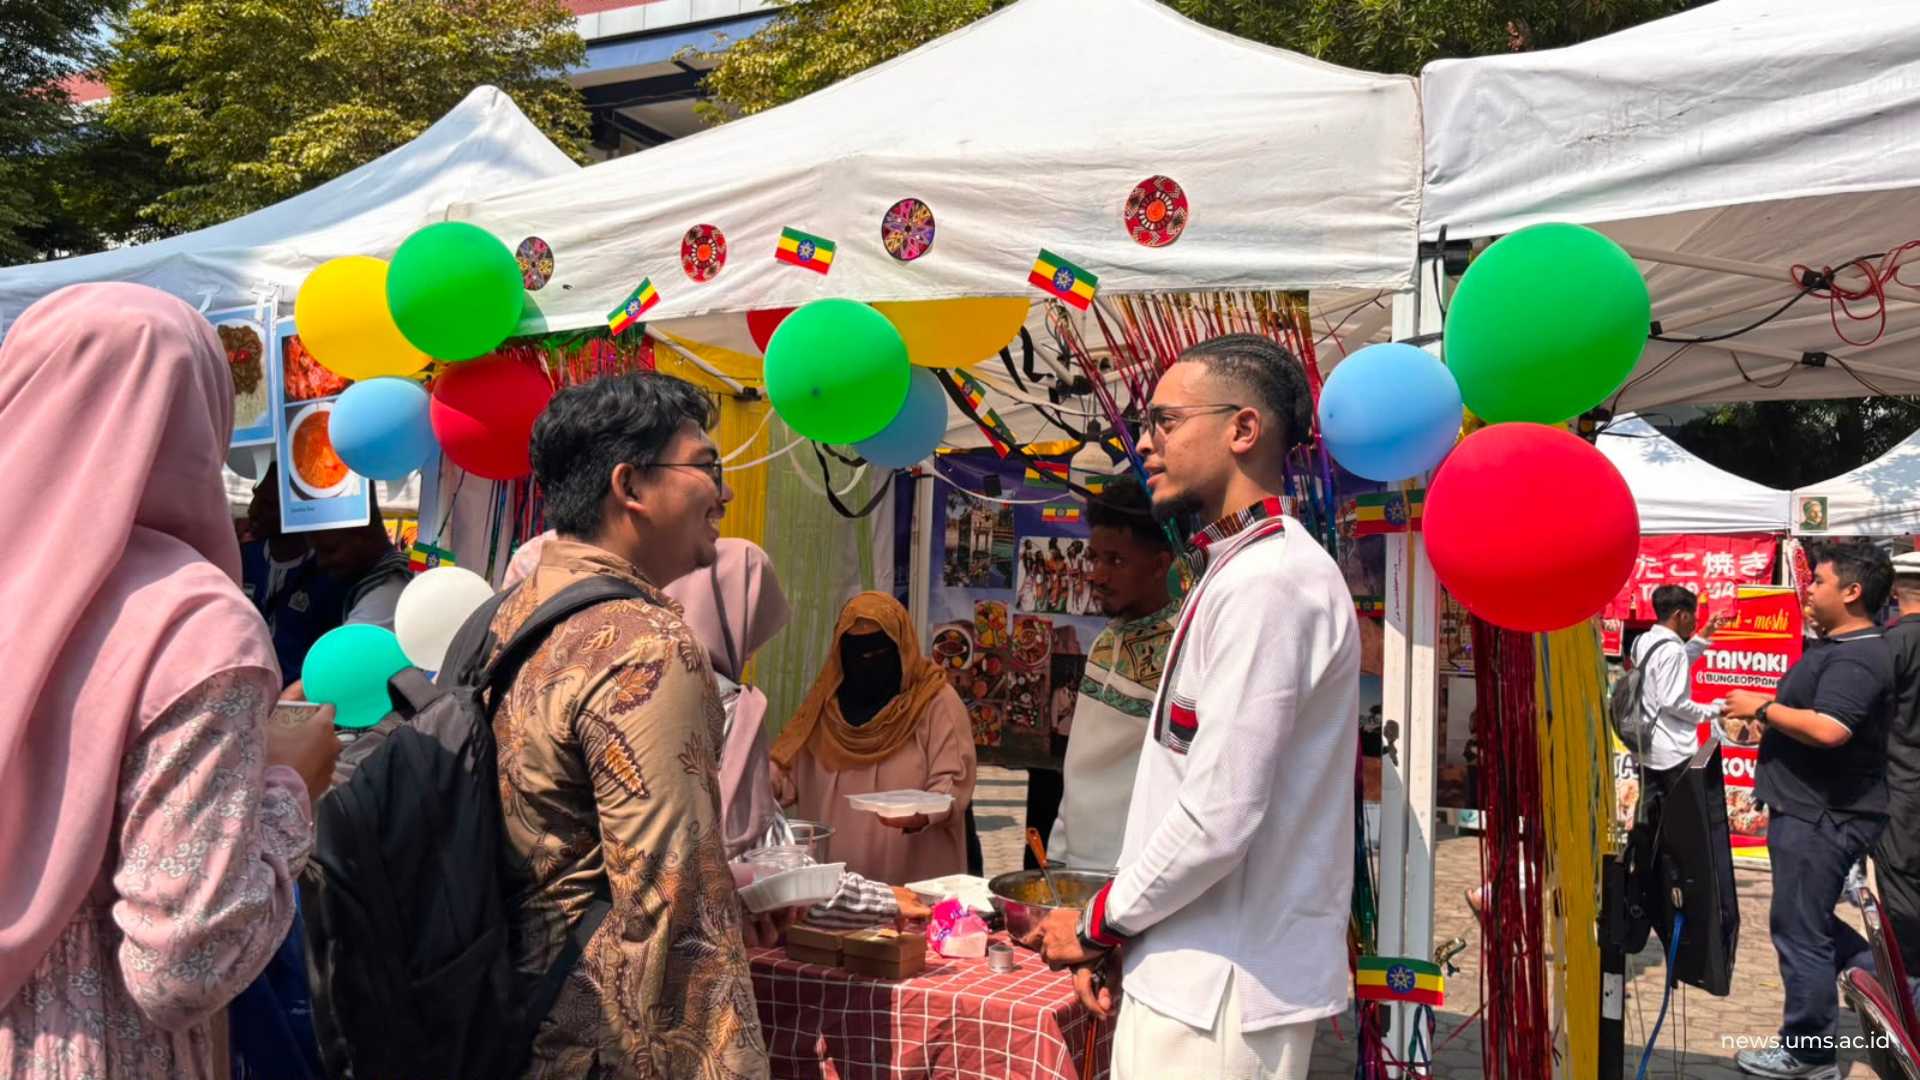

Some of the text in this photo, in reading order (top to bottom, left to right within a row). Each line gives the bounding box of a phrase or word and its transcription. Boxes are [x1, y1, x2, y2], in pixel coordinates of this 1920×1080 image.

[1635, 551, 1769, 579] たこ焼き
[1703, 649, 1788, 673] TAIYAKI
